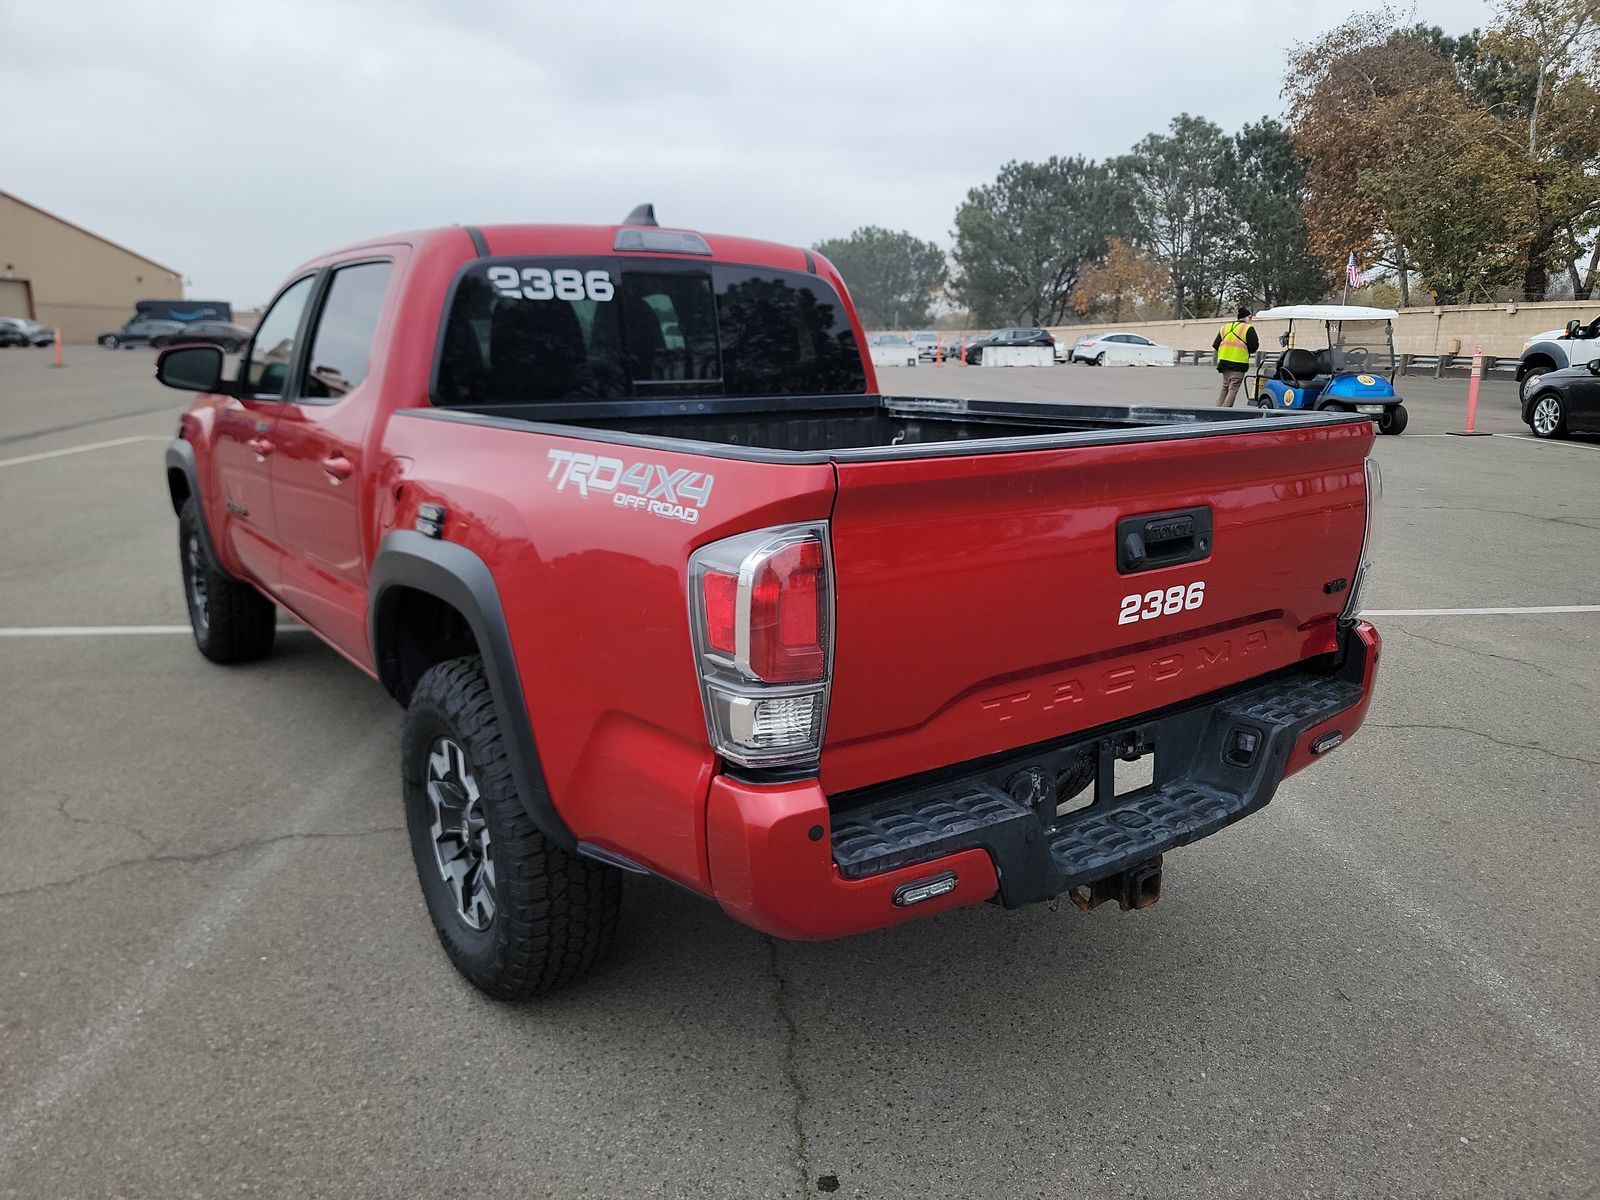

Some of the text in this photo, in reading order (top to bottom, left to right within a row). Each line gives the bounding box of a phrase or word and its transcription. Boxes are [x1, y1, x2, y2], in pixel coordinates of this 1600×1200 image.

[487, 266, 614, 301] 2386
[547, 449, 715, 508] TRD 4X4
[613, 492, 699, 524] OFF ROAD
[1150, 520, 1194, 540] TOYOTA
[1118, 582, 1206, 625] 2386
[981, 629, 1269, 721] TACOMA
